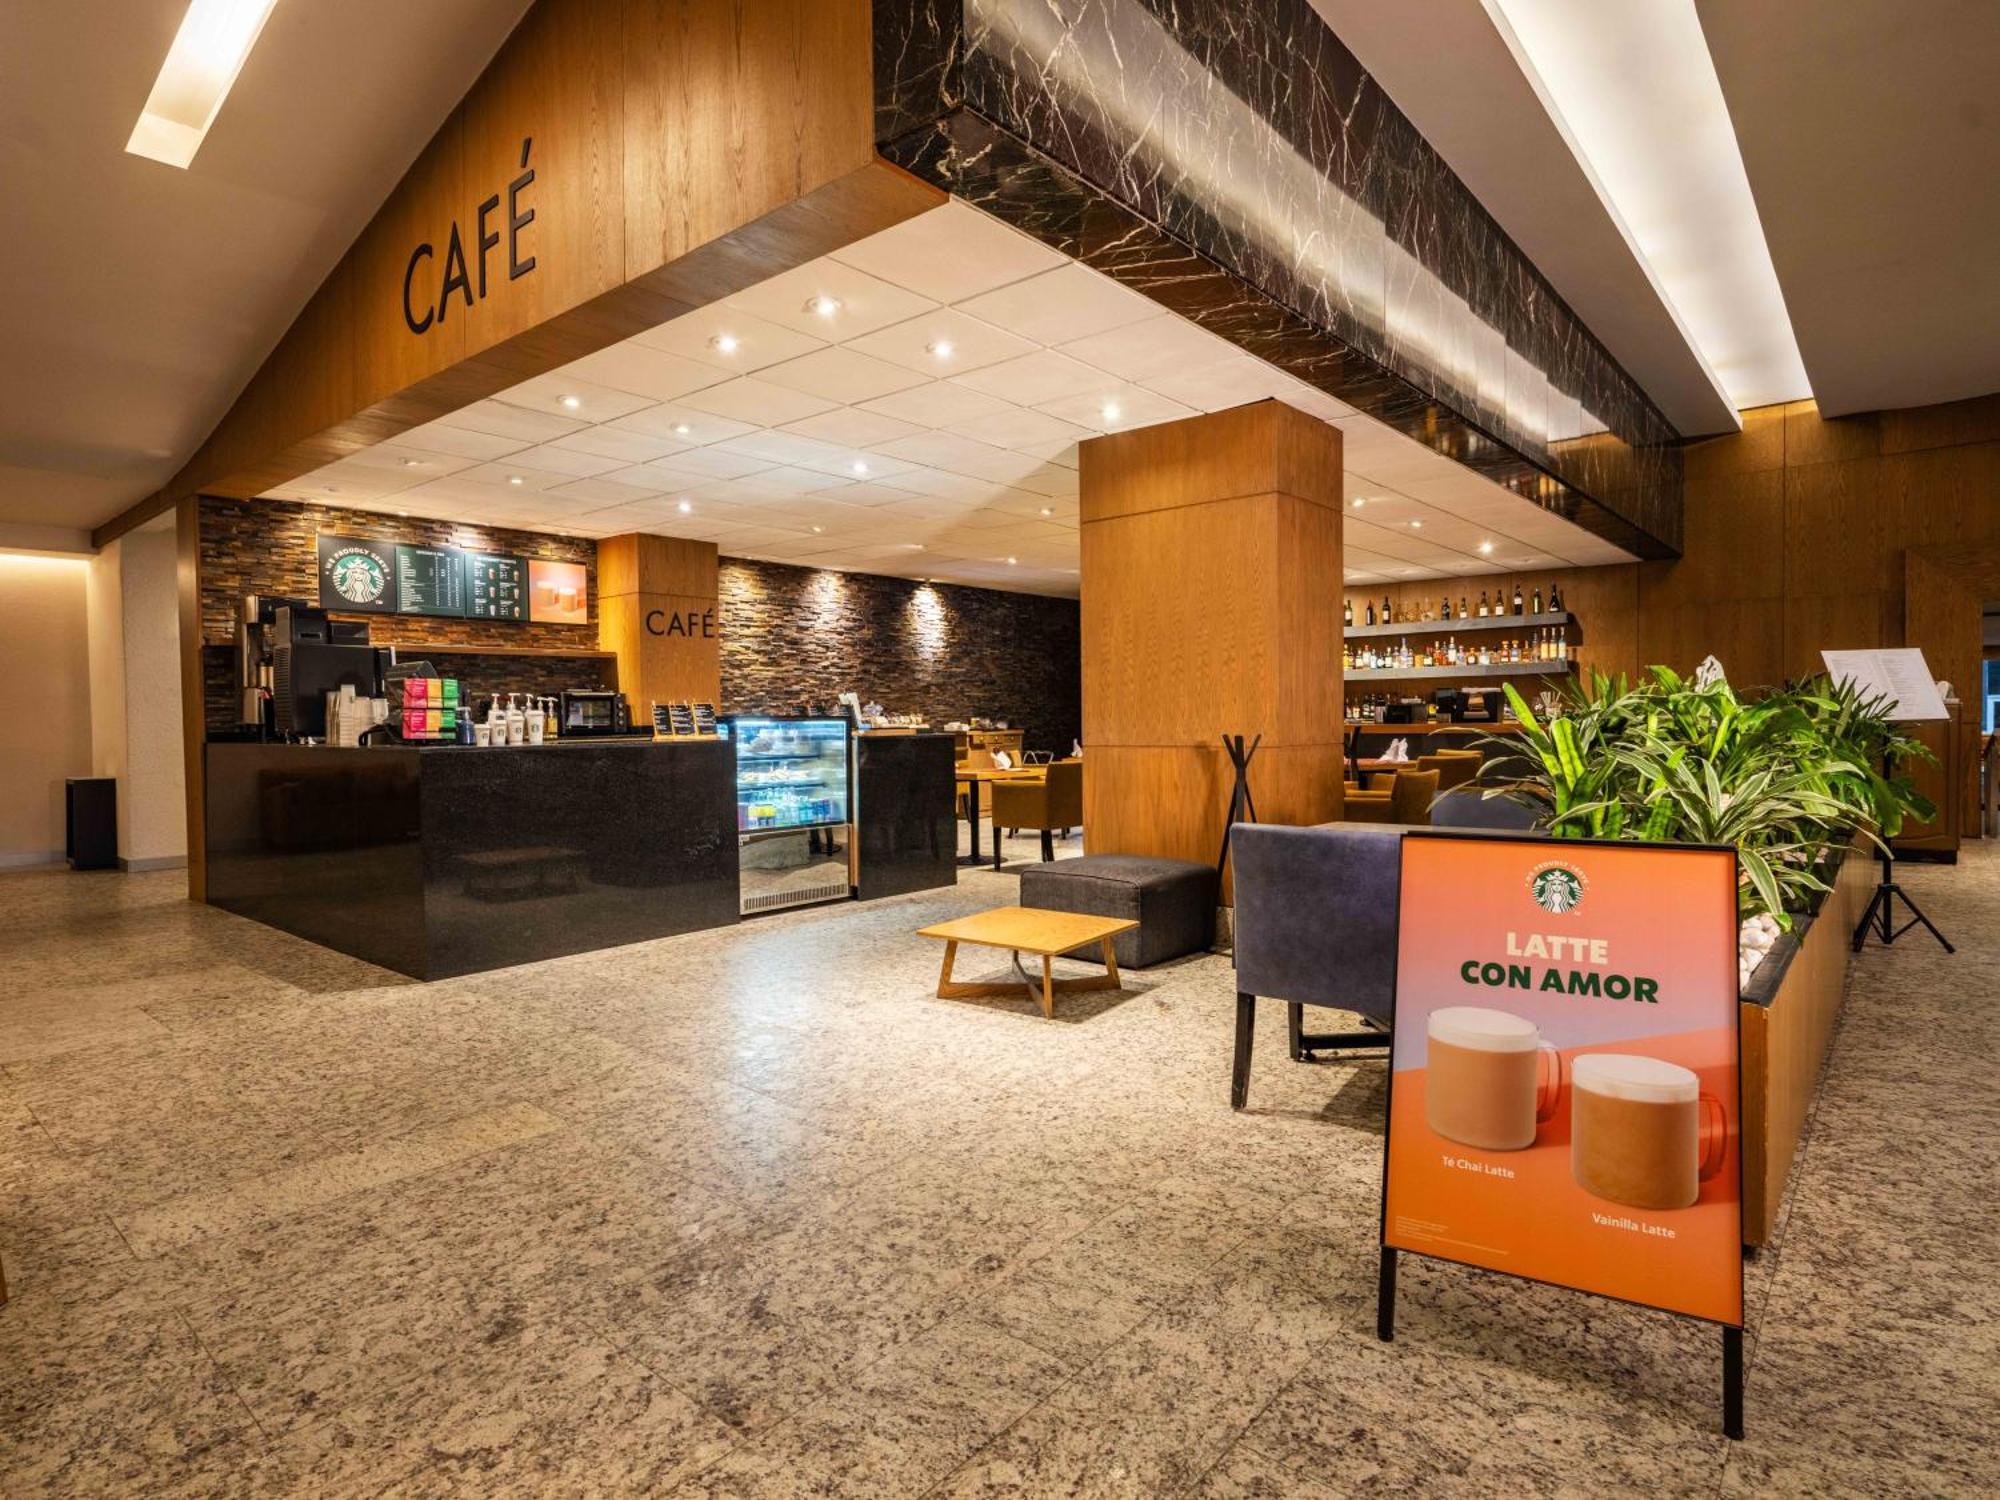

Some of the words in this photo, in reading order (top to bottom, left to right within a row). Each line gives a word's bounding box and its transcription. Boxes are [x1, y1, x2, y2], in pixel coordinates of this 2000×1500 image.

[403, 137, 536, 335] CAFÉ
[646, 608, 715, 638] CAFÉ
[1506, 932, 1608, 965] LATTE
[1461, 960, 1531, 990] CON
[1540, 969, 1659, 1004] AMOR
[1456, 1158, 1482, 1173] Chai
[1485, 1163, 1515, 1179] Latte
[1592, 1212, 1639, 1232] Vainilla
[1642, 1222, 1676, 1239] Latte
